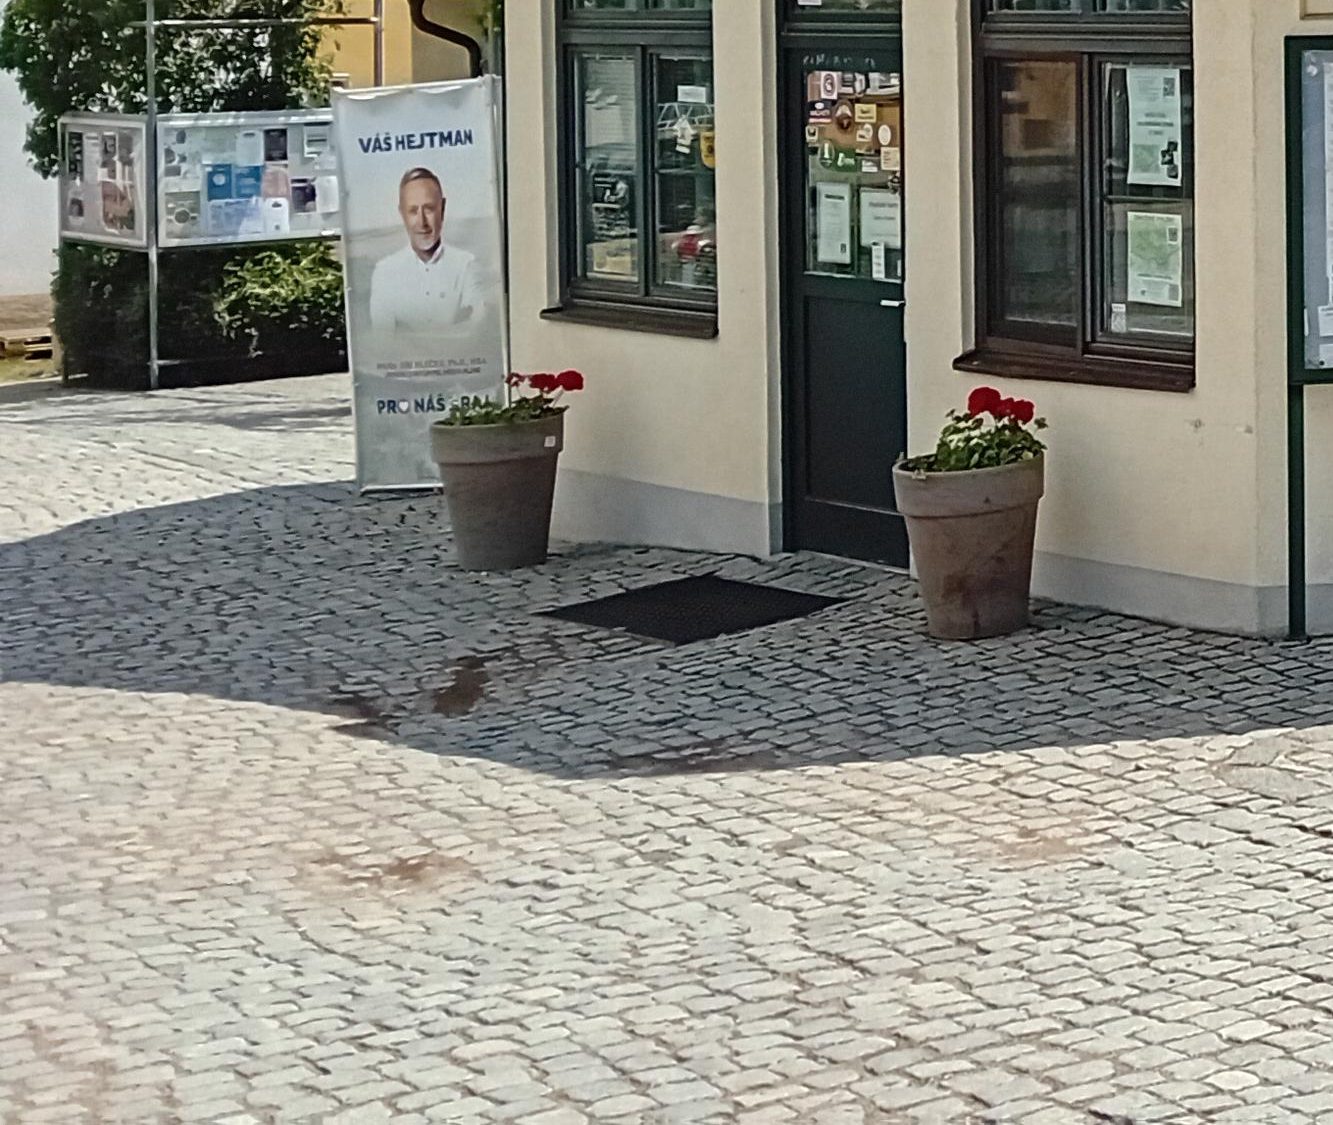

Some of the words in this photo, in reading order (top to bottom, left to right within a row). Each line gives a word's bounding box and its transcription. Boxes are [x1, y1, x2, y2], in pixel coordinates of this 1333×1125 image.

[358, 132, 392, 153] VÁŠ
[395, 129, 473, 151] HEJTMAN
[414, 393, 446, 413] NÁŠ
